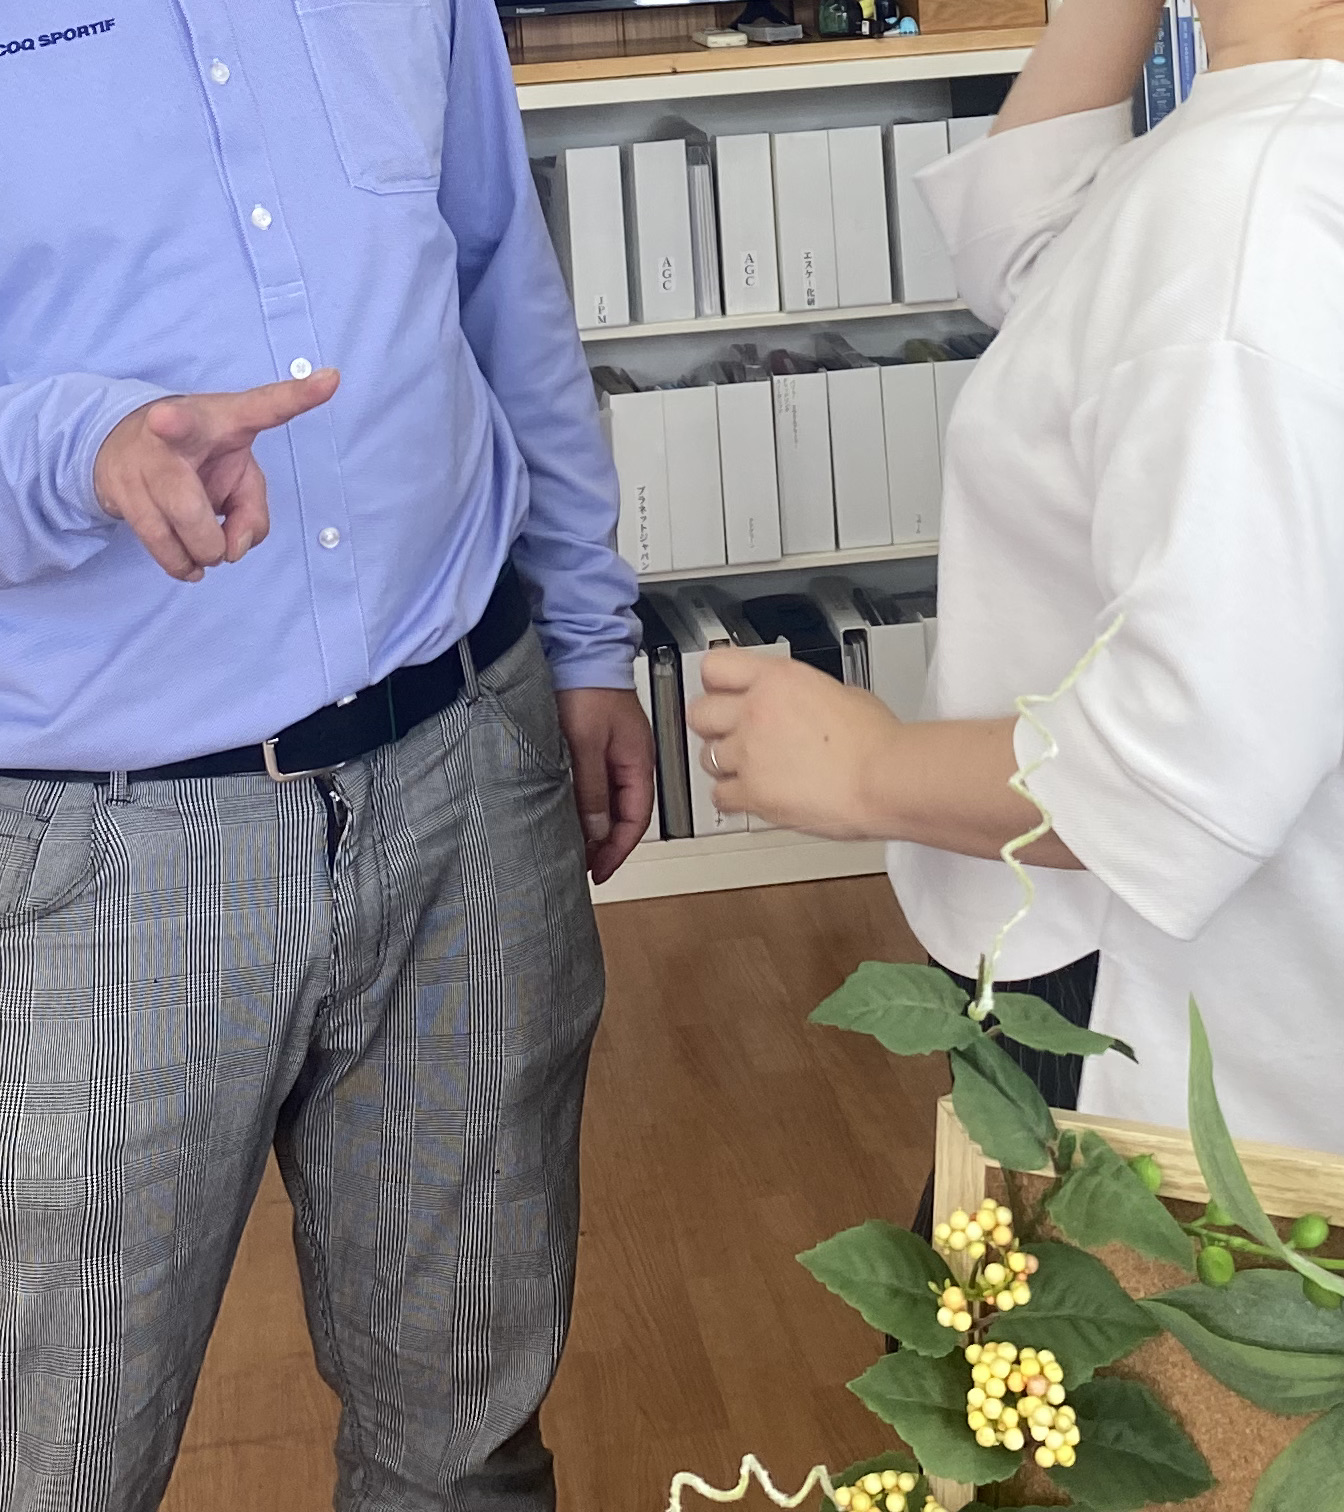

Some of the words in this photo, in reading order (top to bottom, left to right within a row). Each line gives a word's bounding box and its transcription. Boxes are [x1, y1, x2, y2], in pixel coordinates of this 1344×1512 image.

[38, 18, 116, 47] SPORTIF
[662, 256, 672, 290] AGC
[745, 253, 755, 287] AGC
[596, 296, 607, 324] JPM
